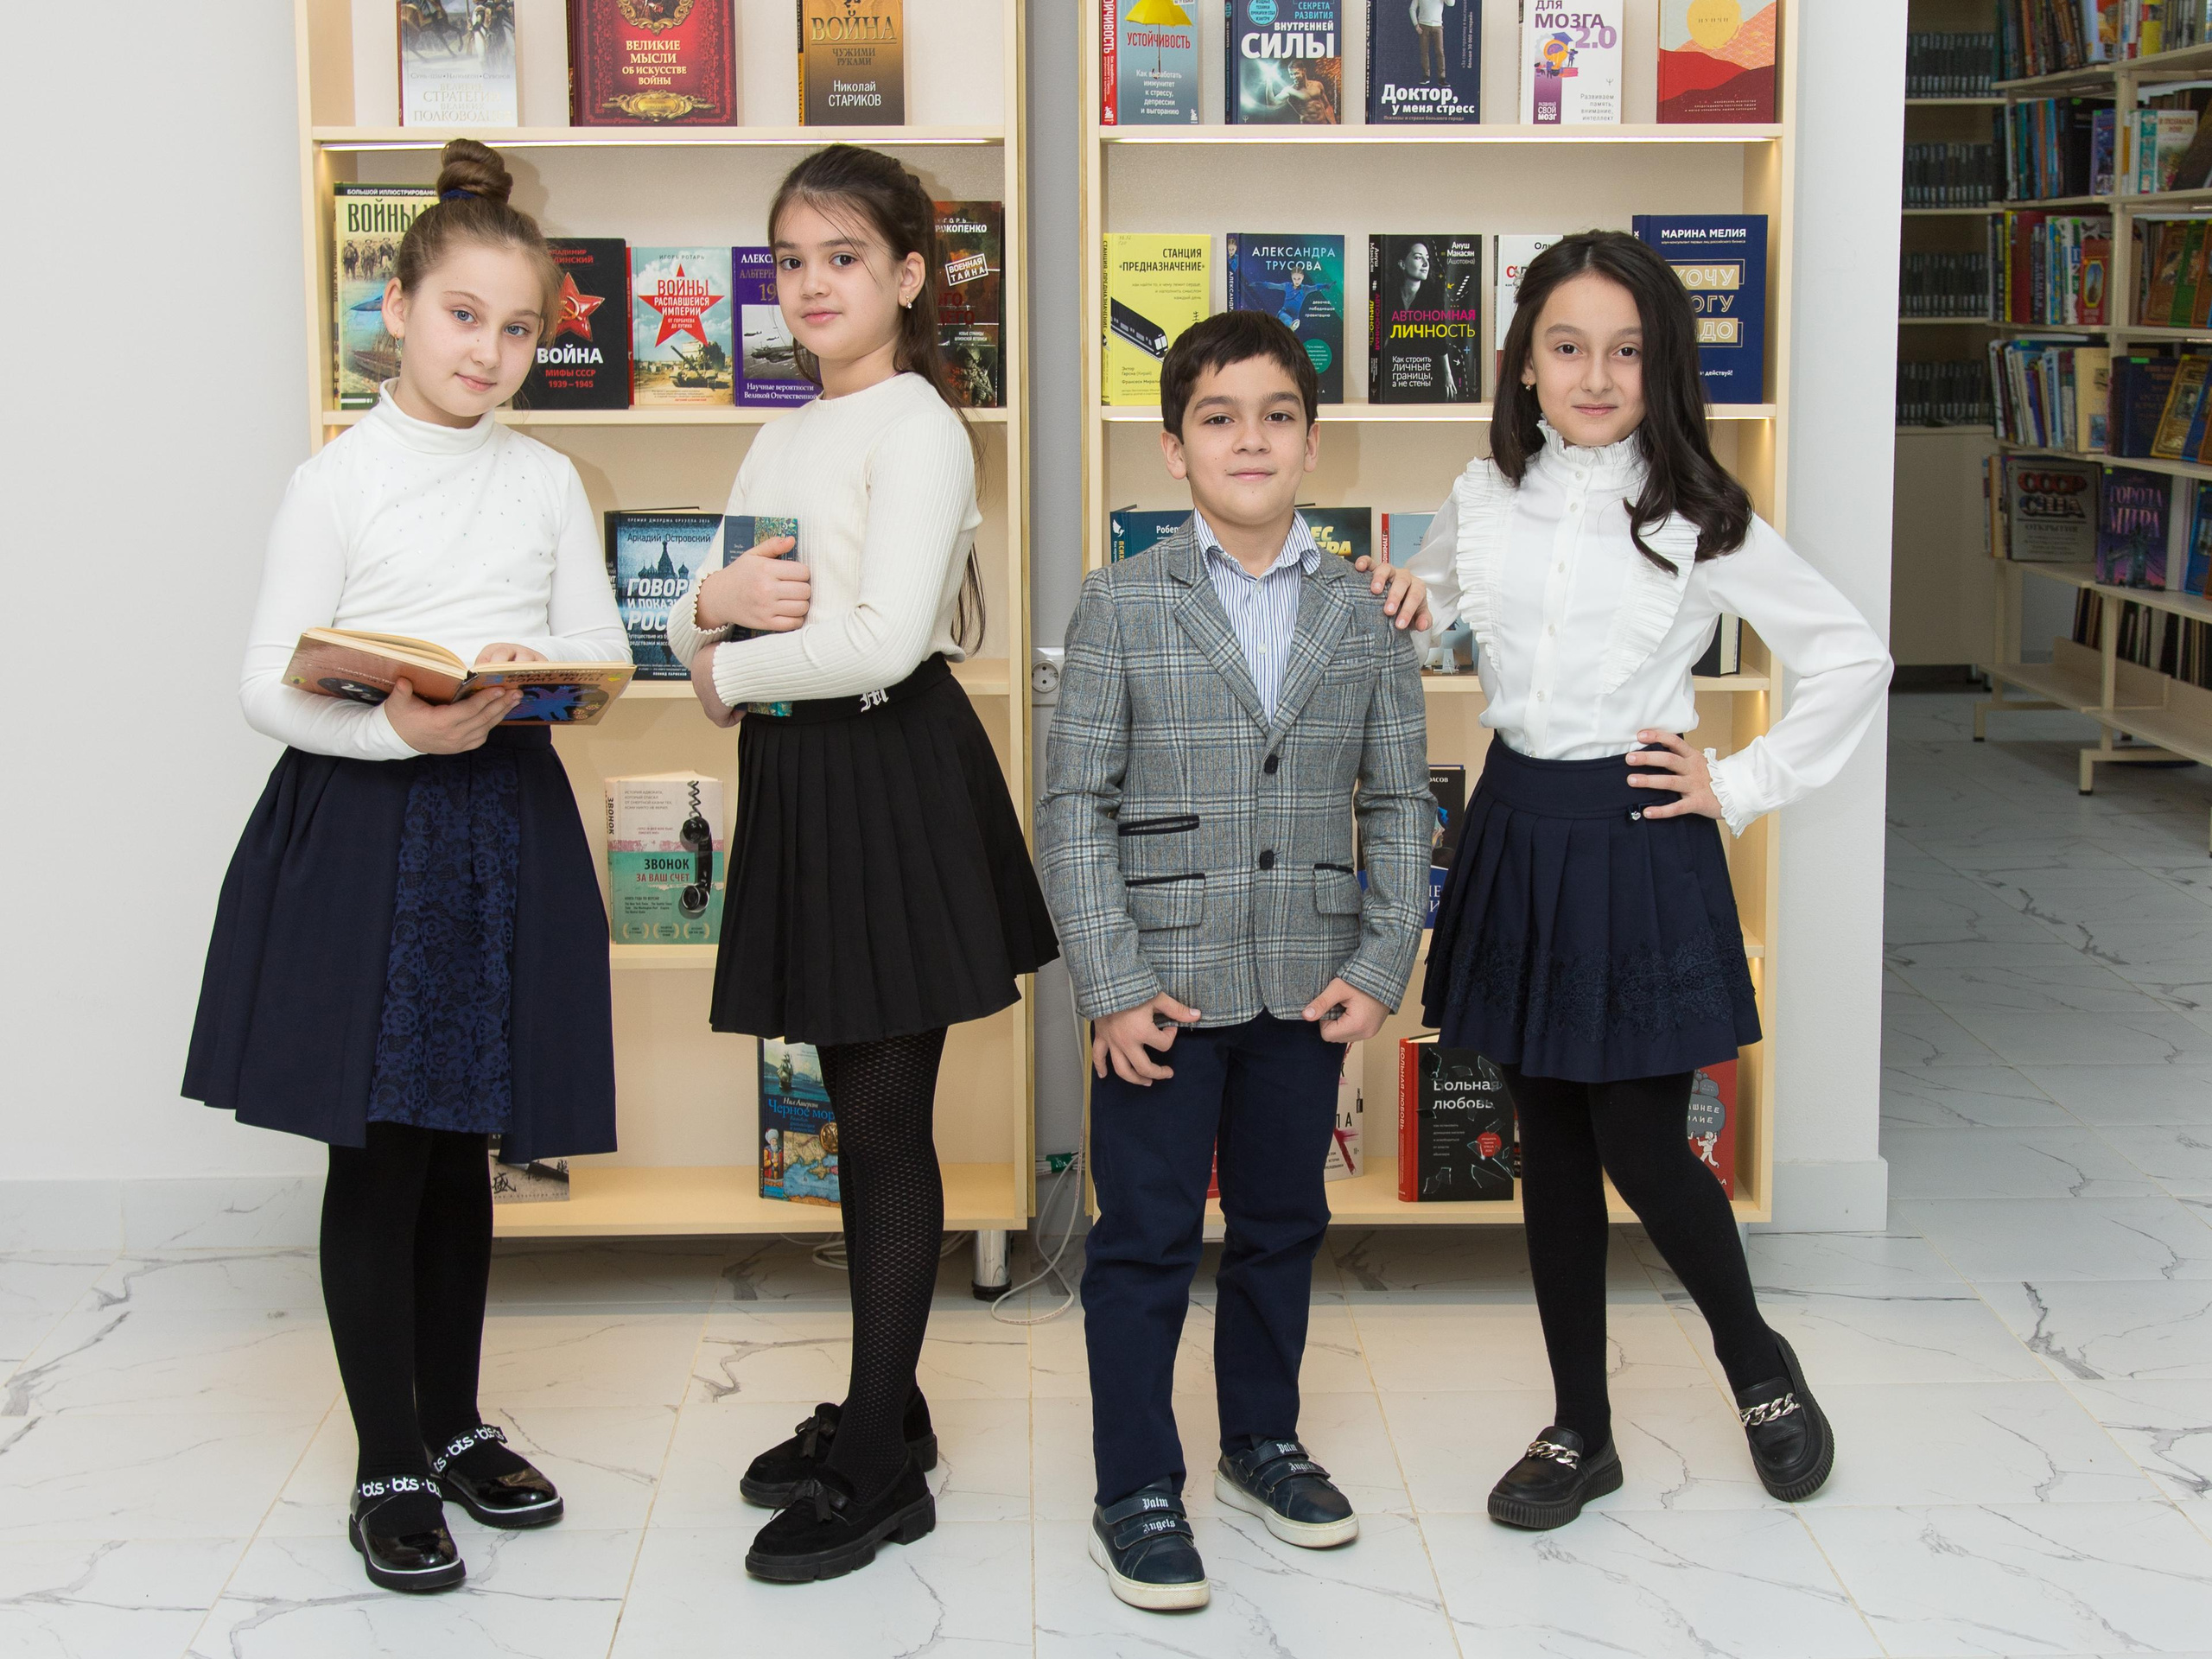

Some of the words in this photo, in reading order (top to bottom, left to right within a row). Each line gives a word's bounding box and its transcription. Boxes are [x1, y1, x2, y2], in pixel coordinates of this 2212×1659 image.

[1298, 2, 1331, 10] СЕКРЕТА
[1294, 10, 1334, 20] РАЗВИТИЯ
[1535, 13, 1605, 29] МОЗГА
[810, 10, 897, 41] ВОЙНА
[1274, 20, 1334, 31] ВНУТРЕННЕЙ
[1127, 30, 1192, 50] УСТОЙЧИВОСТЬ
[1575, 25, 1618, 49] 2.0
[626, 40, 681, 52] ВЕЛИКИЕ
[1241, 32, 1335, 59] СИЛЫ
[630, 53, 677, 65] МЫСЛИ
[832, 48, 876, 58] ЧУЖИМИ
[836, 57, 872, 67] РУКАМИ
[621, 66, 635, 75] ОБ
[636, 66, 688, 76] ИСКУССТВЕ
[1136, 69, 1147, 78] Как
[638, 75, 672, 86] ВОЙНЫ
[833, 79, 876, 92] Николай
[1143, 79, 1175, 88] иммунитет
[828, 93, 882, 107] СТАРИКОВ
[1381, 84, 1459, 105] Доктор,
[1143, 99, 1176, 107] депрессии
[1146, 107, 1179, 116] выгоранию
[1391, 105, 1401, 116] у
[1402, 105, 1433, 114] меня
[1436, 105, 1475, 116] стресс
[1538, 105, 1557, 114] СВОЙ
[347, 198, 417, 233] ВОЙНЫ
[1661, 229, 1707, 238] МАРИНА
[1709, 228, 1746, 238] МЕЛИЯ
[1452, 241, 1470, 250] Ануш
[1162, 248, 1202, 259] СТАНЦИЯ
[1252, 246, 1336, 258] АЛЕКСАНДРА
[1446, 249, 1475, 258] Манасян
[741, 254, 774, 264] АЛЕКС
[948, 257, 984, 274] ВОЕННАЯ
[1119, 261, 1205, 273] «ПРЕДНАЗНАЧЕНИЕ»
[1266, 260, 1322, 271] ТРУСОВА
[740, 269, 776, 279] АЛЬТЕРН
[950, 266, 986, 283] ТАЙНА
[1674, 268, 1735, 286] ХОЧУ
[658, 277, 709, 296] ВОЙНЫ
[759, 283, 777, 302] 19
[654, 296, 710, 307] РАСПАВШЕЙСЯ
[1691, 295, 1734, 314] ОГУ
[662, 306, 702, 316] ИМПЕРИИ
[1391, 308, 1477, 322] АВТОНОМНАЯ
[1390, 323, 1476, 339] ЛИЧНОСТЬ
[1700, 321, 1734, 341] ДО
[537, 343, 604, 365] ВОЙНА
[1392, 362, 1432, 372] личные
[545, 369, 575, 378] МИФЫ
[575, 369, 596, 378] СССР
[1392, 372, 1433, 382] границы,
[747, 383, 775, 391] Научные
[775, 384, 814, 393] вероятности
[1156, 524, 1181, 534] Робер
[626, 533, 662, 543] Аркадий
[665, 533, 711, 543] Островский
[627, 578, 691, 597] ГОВОР
[627, 598, 636, 609] И
[638, 598, 677, 609] ПОКАЗ
[627, 611, 668, 631] РОС
[644, 858, 690, 871] ЗВОНОК
[636, 874, 646, 882] ЗА
[649, 873, 668, 882] ВАШ
[670, 873, 690, 882] СЧЕТ
[1433, 1096, 1496, 1110] любовь
[768, 1098, 810, 1119] Черное
[812, 1110, 836, 1123] мор
[448, 1435, 474, 1456] bts
[1276, 1443, 1298, 1454] Palm
[362, 1478, 385, 1497] bts
[391, 1477, 420, 1492] bts
[1142, 1497, 1169, 1510] Palm
[1142, 1518, 1176, 1534] Angels
